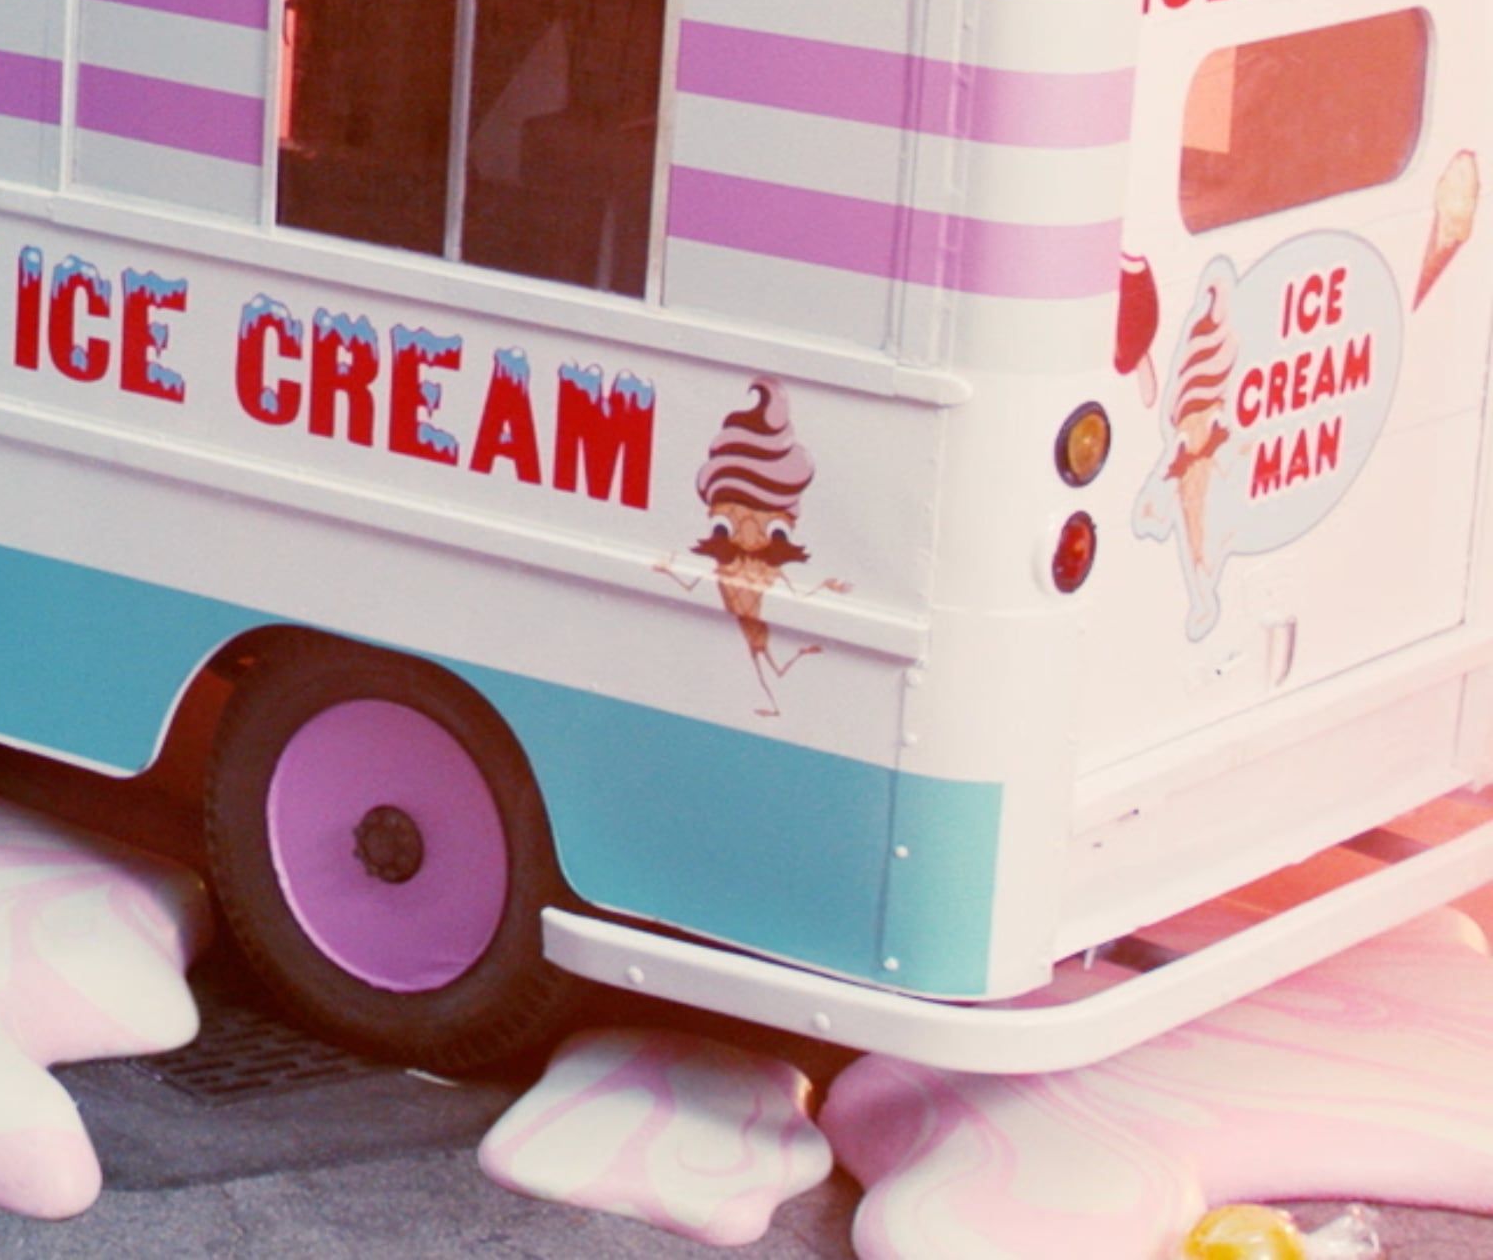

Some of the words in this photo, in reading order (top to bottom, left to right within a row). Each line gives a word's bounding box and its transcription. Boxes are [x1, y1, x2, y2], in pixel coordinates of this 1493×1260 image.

[1282, 266, 1347, 339] ICE
[13, 244, 189, 404] ICE
[234, 292, 656, 511] CREAM
[1236, 333, 1371, 428] CREAM
[1250, 416, 1342, 500] MAN
